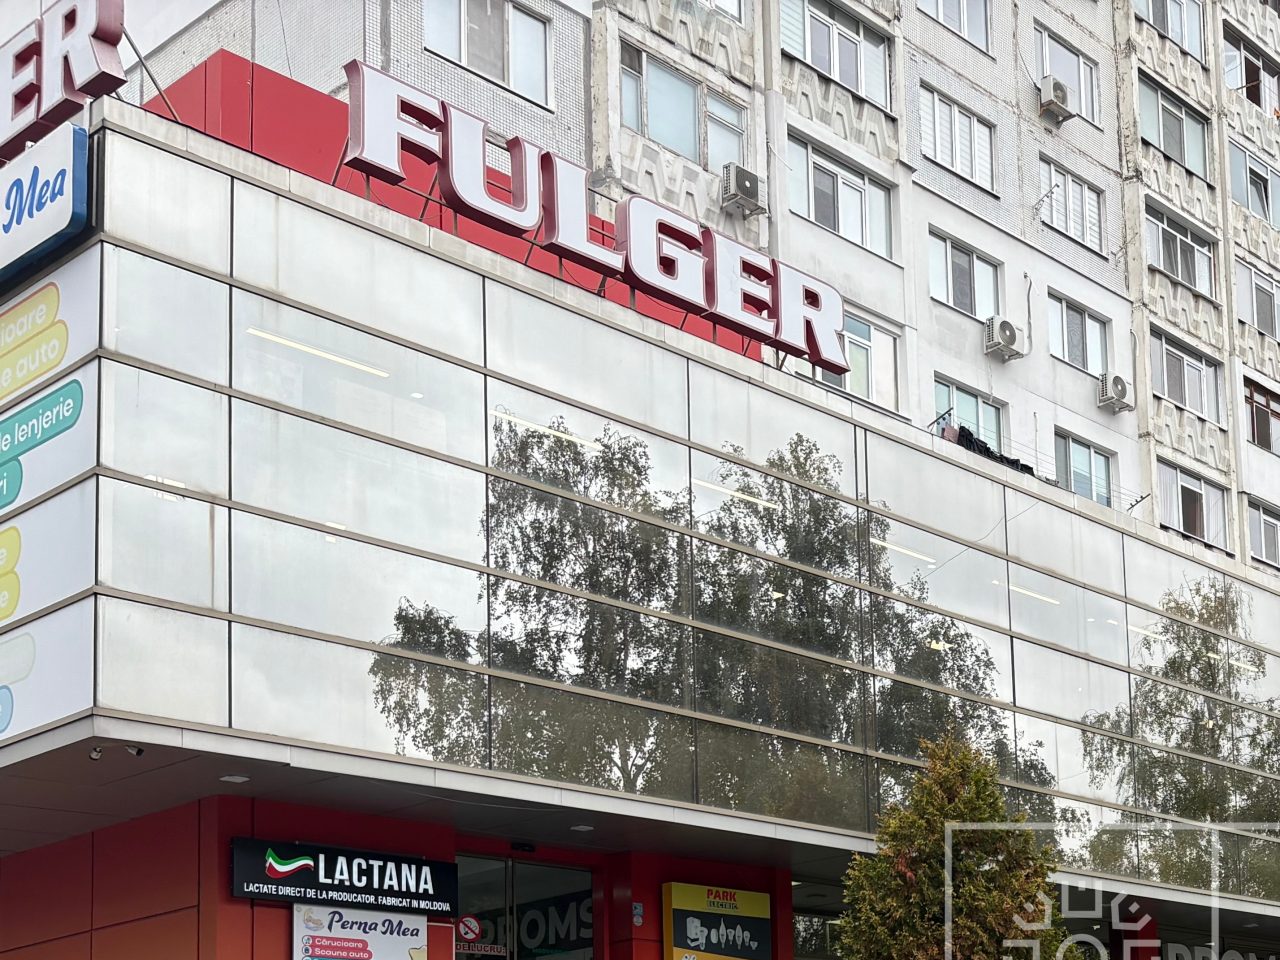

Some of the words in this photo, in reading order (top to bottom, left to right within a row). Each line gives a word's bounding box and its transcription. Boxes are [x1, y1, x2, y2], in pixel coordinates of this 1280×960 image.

[2, 166, 67, 234] Mea
[344, 58, 850, 375] FULGER
[15, 396, 73, 445] lenjerie
[318, 853, 434, 895] LACTANA
[706, 888, 736, 902] PARK
[244, 882, 277, 895] LACTATE
[278, 886, 305, 898] DIRECT
[306, 888, 316, 898] DE
[317, 889, 327, 899] LA
[378, 896, 410, 908] FABRICAT
[411, 899, 419, 909] IN
[420, 900, 451, 912] MOLDOVA
[327, 910, 379, 934] Perna
[380, 918, 420, 937] Mea
